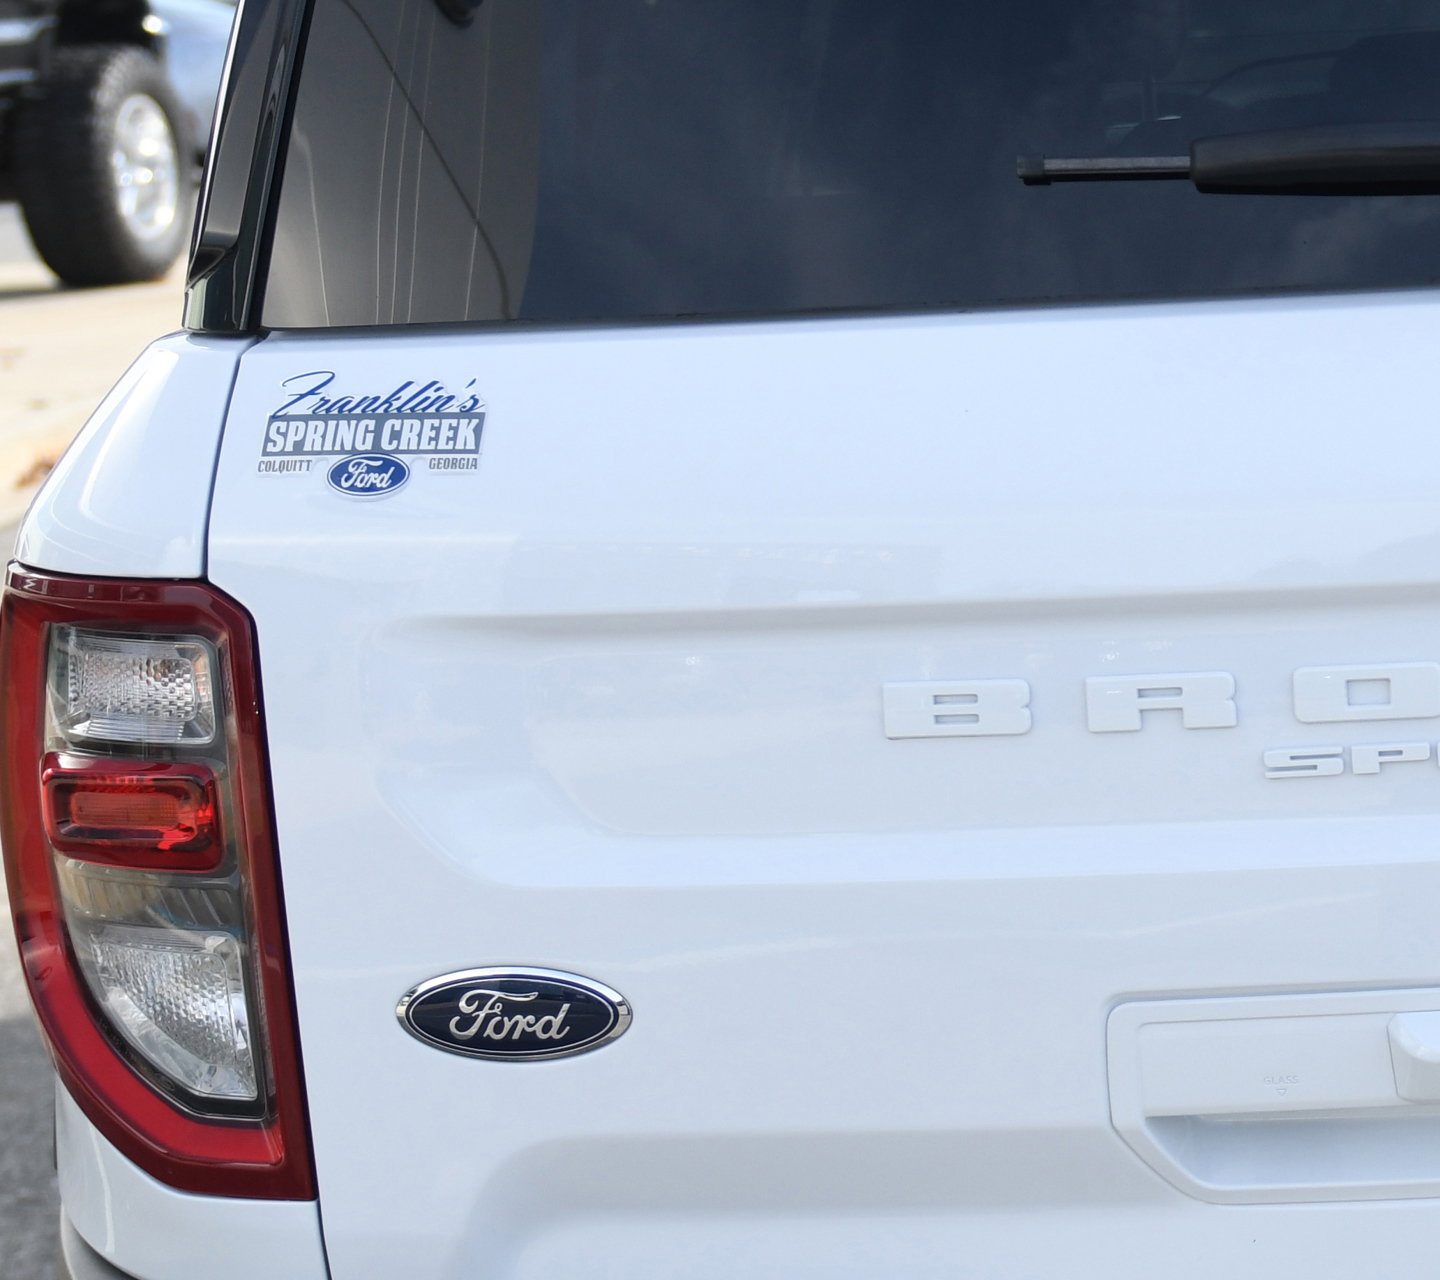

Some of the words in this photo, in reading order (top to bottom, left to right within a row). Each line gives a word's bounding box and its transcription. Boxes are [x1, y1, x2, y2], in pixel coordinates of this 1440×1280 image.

[271, 371, 485, 419] Franklin's
[266, 419, 376, 452] SPRING
[380, 418, 480, 451] CREEK
[257, 459, 313, 474] COLQUITT
[340, 458, 396, 489] Ford
[428, 457, 478, 470] GEORGIA
[448, 988, 571, 1040] Ford
